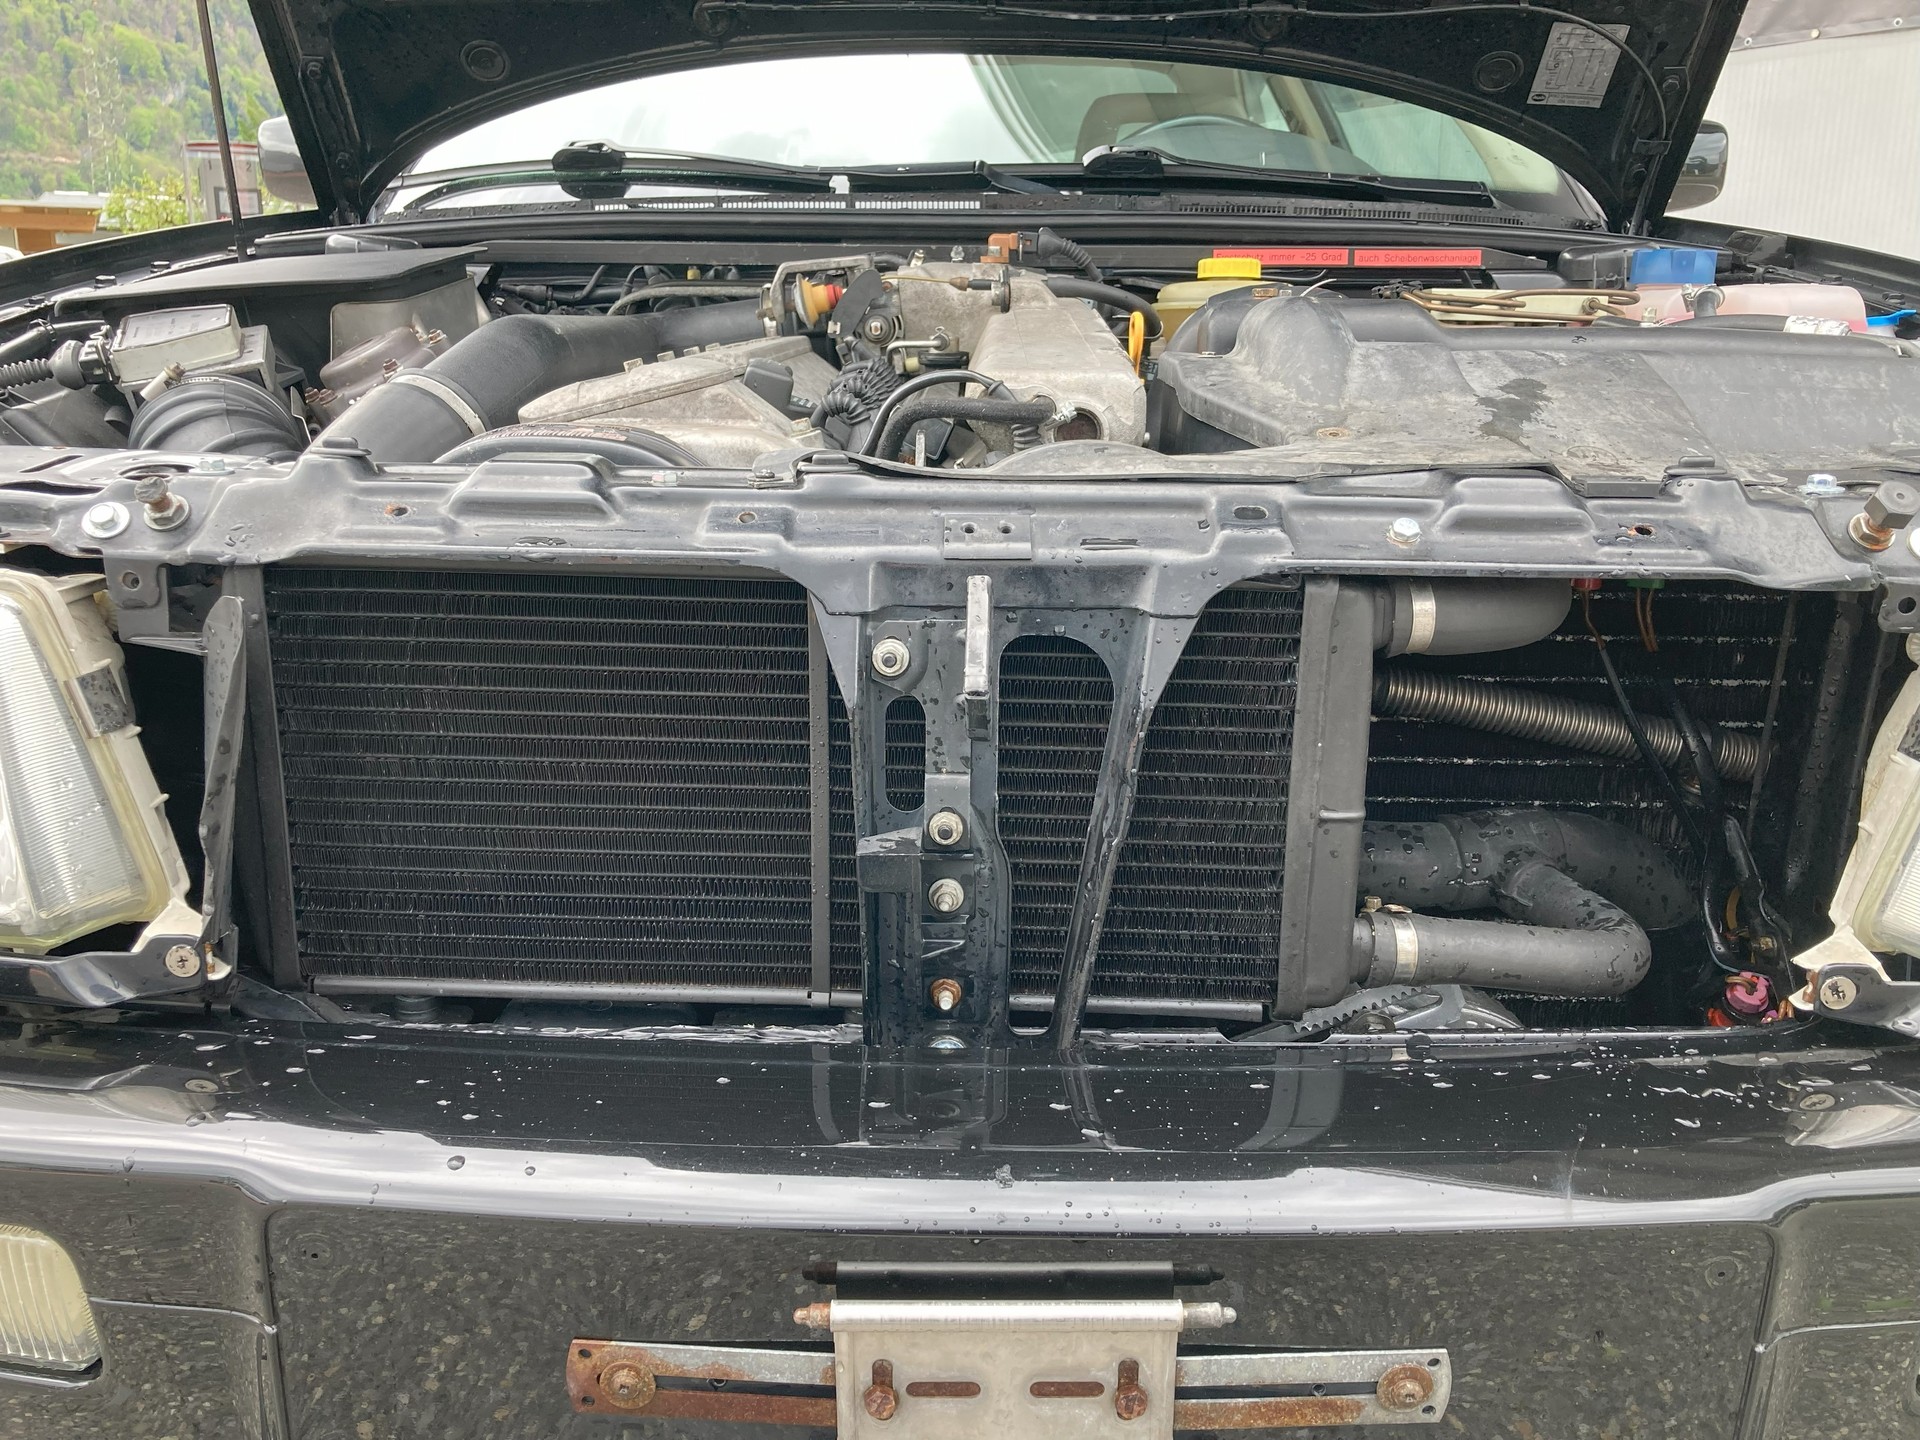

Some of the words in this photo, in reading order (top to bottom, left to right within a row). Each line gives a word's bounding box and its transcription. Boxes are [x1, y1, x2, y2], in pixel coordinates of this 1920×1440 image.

[1301, 253, 1317, 261] -25
[1321, 253, 1342, 261] Grad
[1358, 254, 1380, 262] auch
[1384, 253, 1478, 263] Scheibenwaschanlage
